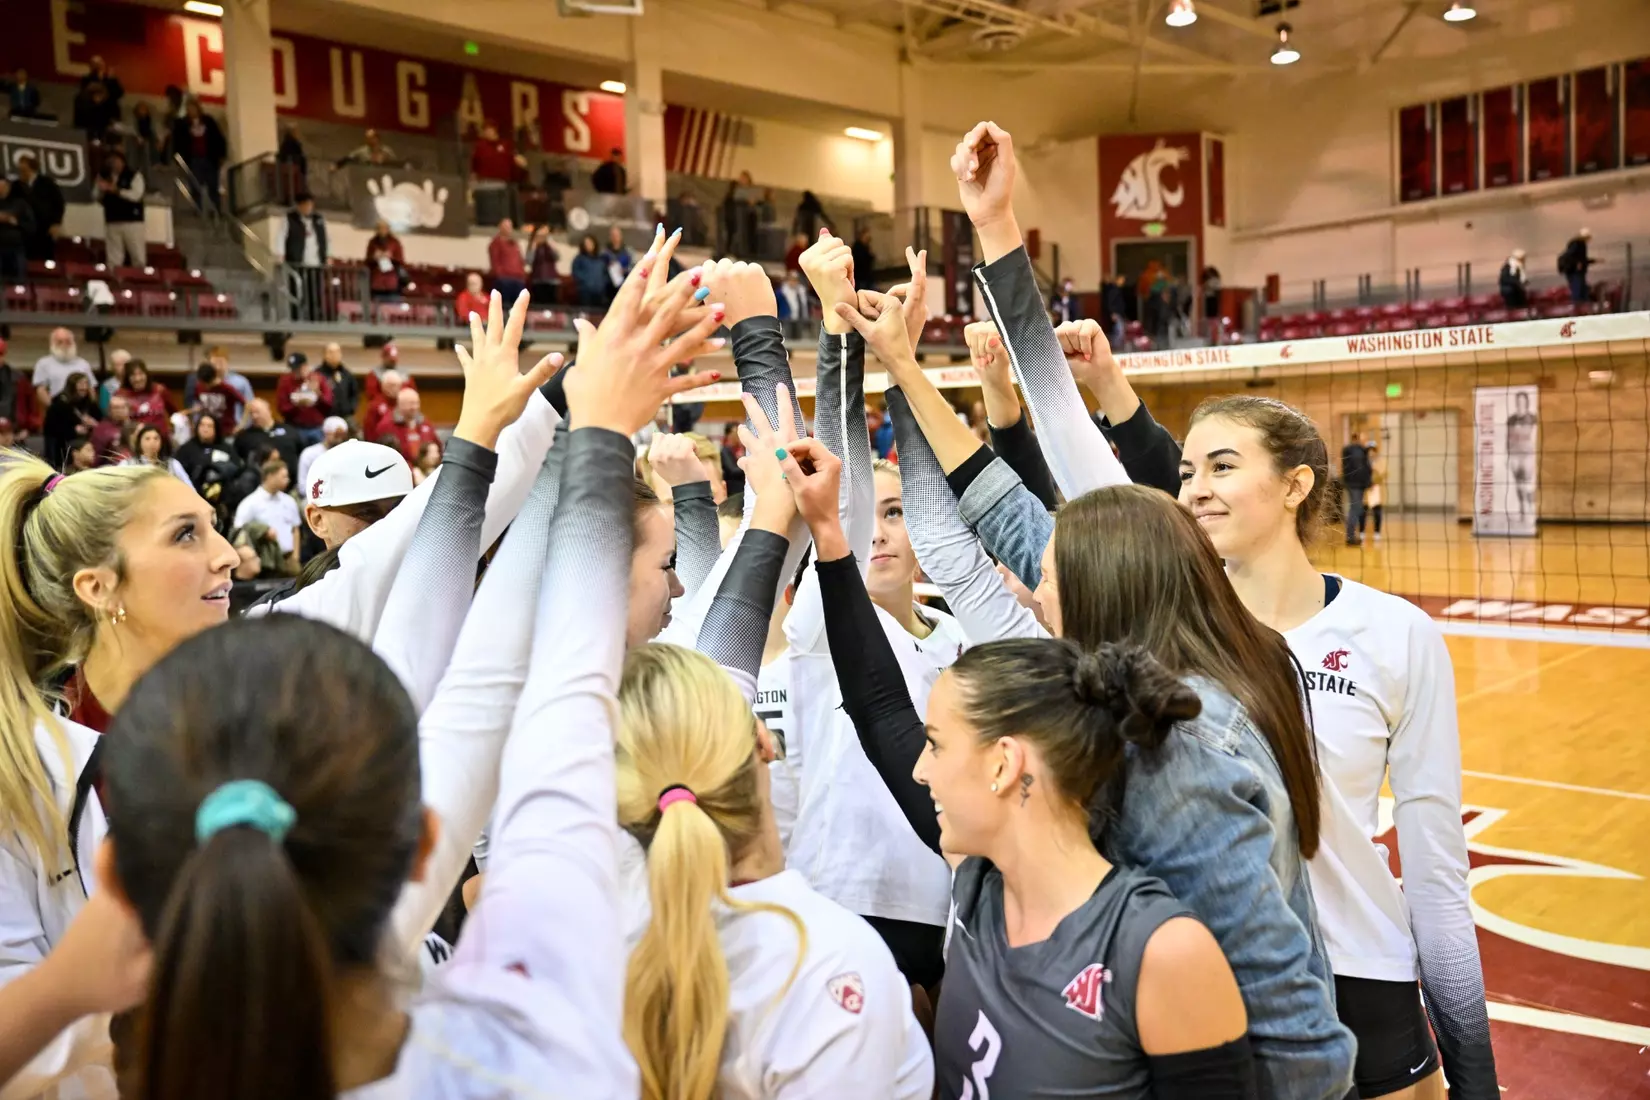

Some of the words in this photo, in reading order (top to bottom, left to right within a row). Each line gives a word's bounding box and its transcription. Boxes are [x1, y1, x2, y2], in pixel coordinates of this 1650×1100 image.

[182, 18, 592, 152] COUGARS
[1347, 330, 1443, 353] WASHINGTON
[1449, 326, 1494, 344] STATE
[1119, 352, 1192, 369] WASHINGTON
[1196, 349, 1231, 364] STATE
[1480, 403, 1494, 434] STATE
[1440, 599, 1650, 626] WAS
[1305, 671, 1357, 696] STATE
